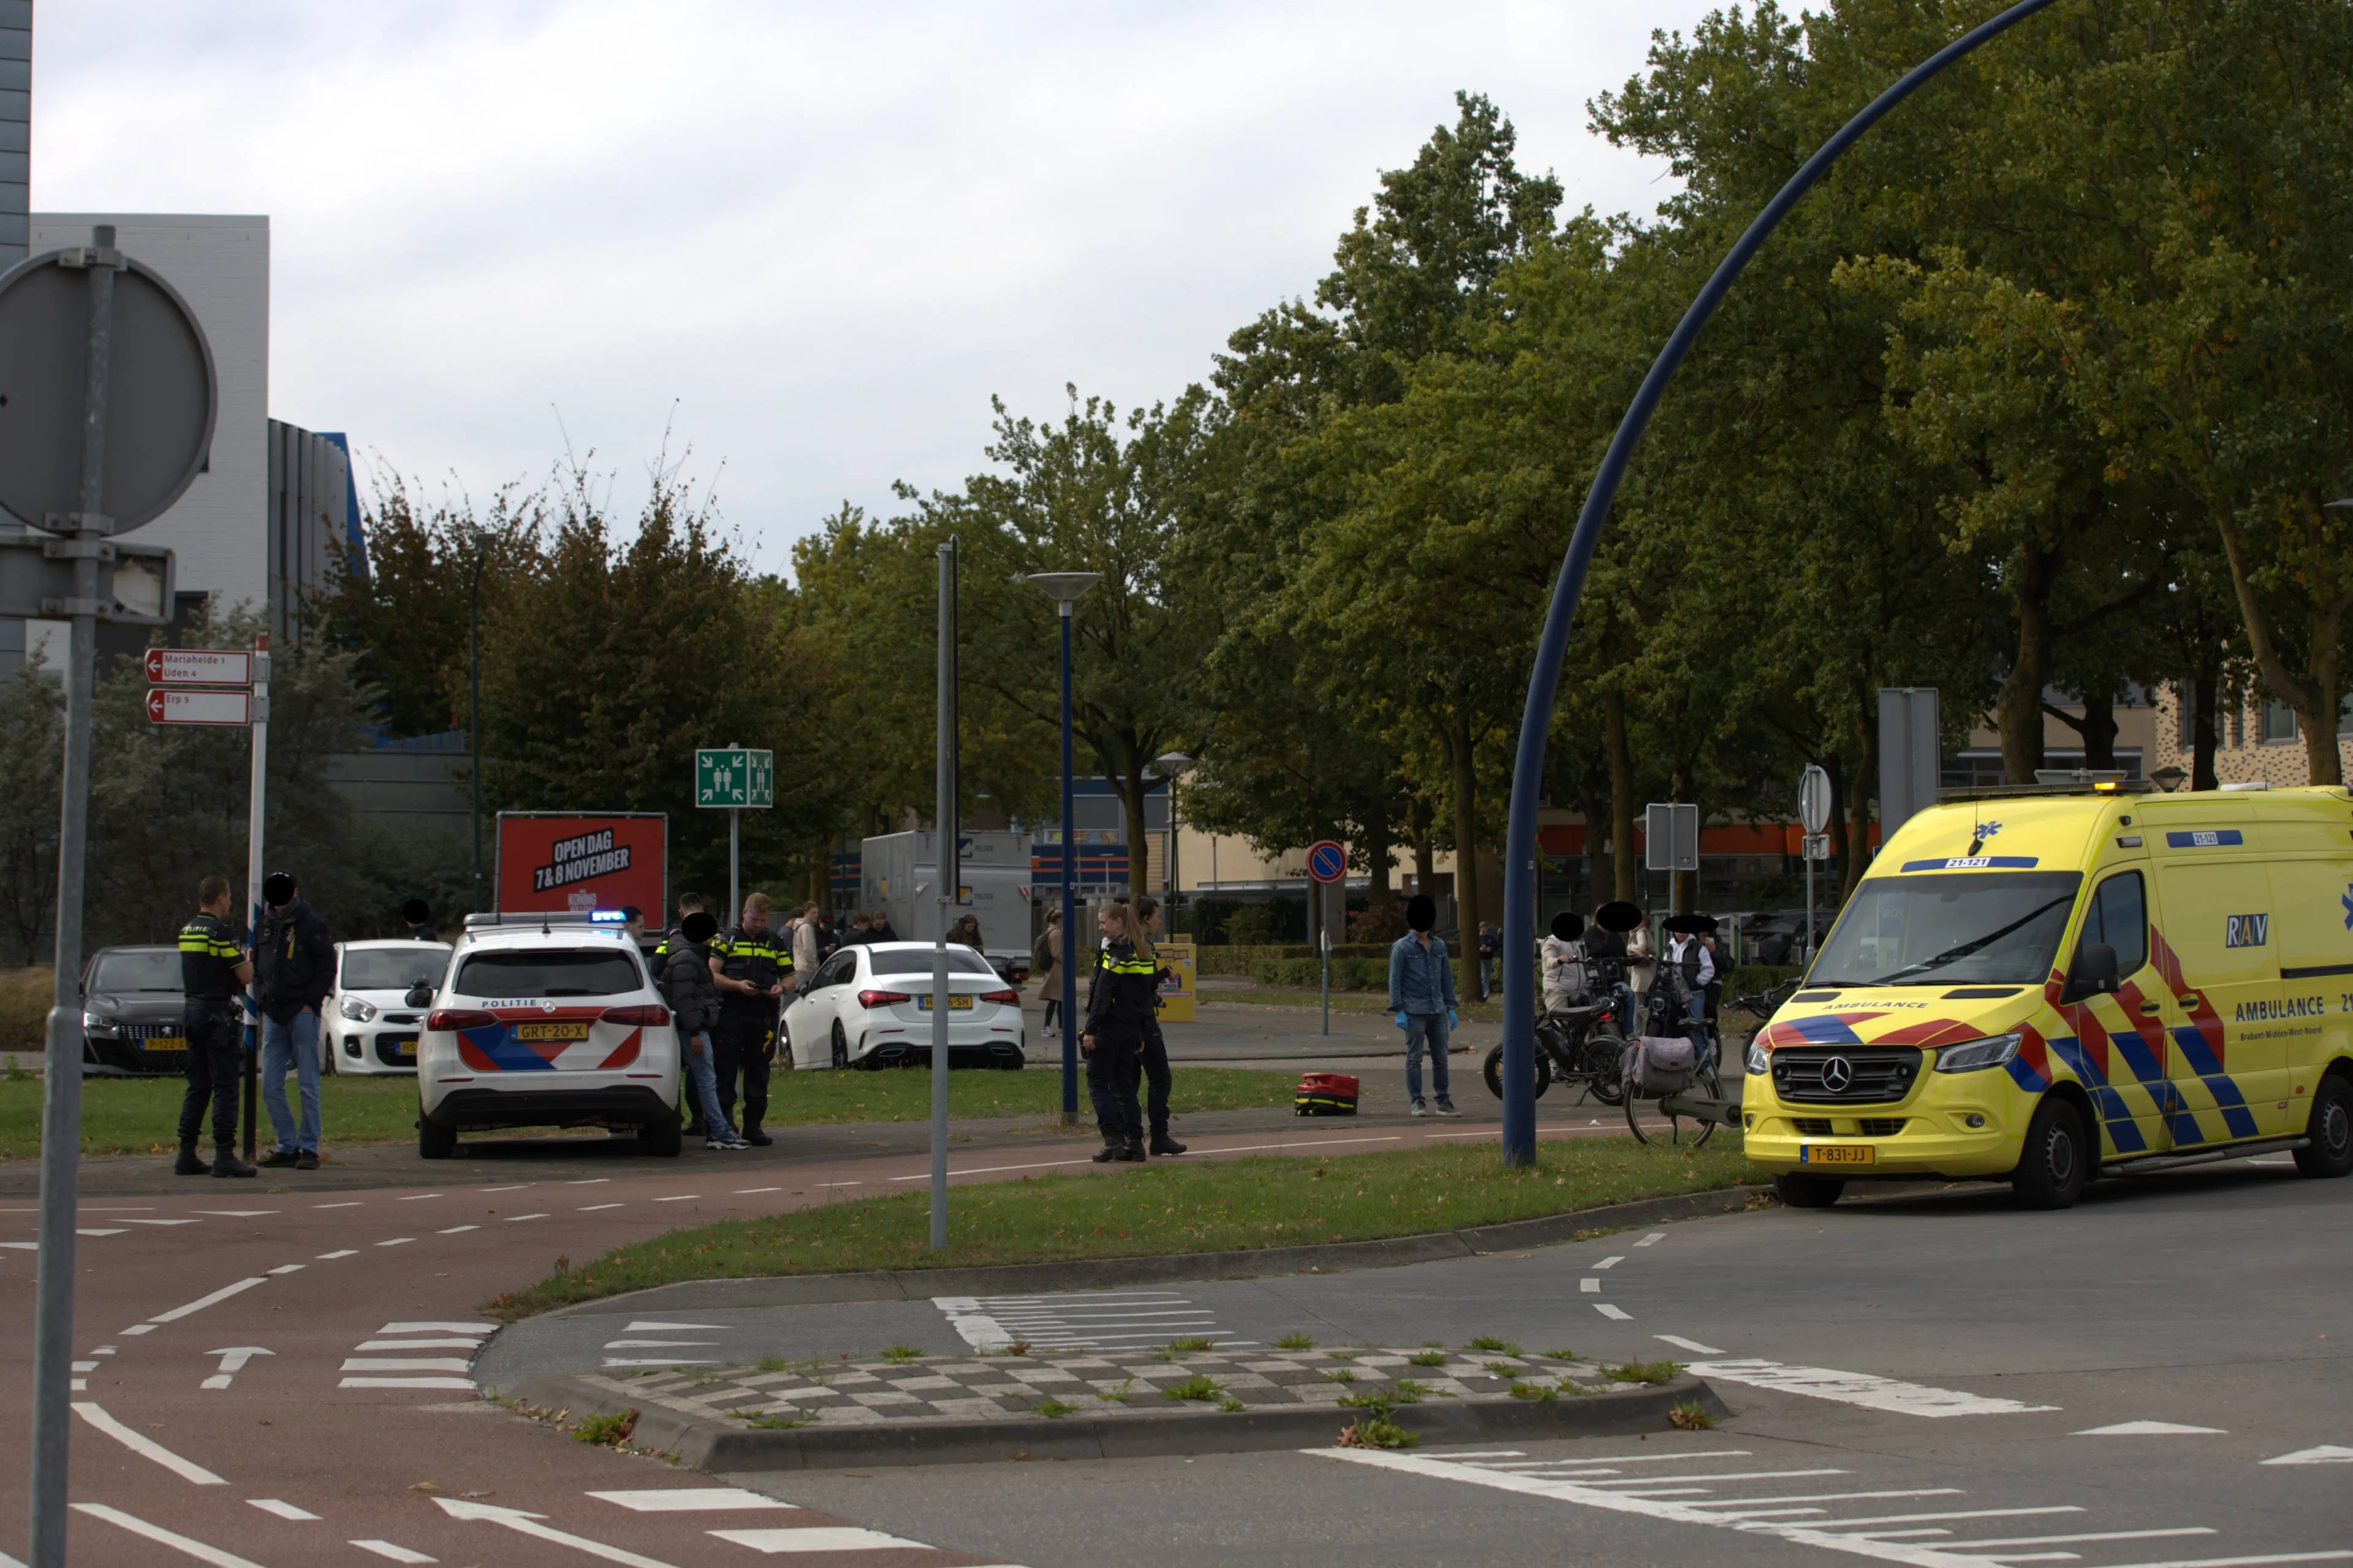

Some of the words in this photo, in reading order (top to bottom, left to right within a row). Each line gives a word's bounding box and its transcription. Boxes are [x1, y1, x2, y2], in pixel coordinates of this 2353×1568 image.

[165, 655, 218, 664] Mariaheide
[166, 694, 181, 703] Erp
[2195, 834, 2216, 843] 21-121
[555, 836, 586, 863] OPEN
[586, 830, 612, 854] DAG
[565, 848, 629, 882] NOVEMBER
[2227, 915, 2267, 945] RAV
[482, 999, 536, 1008] POLITIE
[2236, 996, 2324, 1022] AMBULANCE
[522, 1026, 583, 1037] GRT-20-X
[2240, 1026, 2322, 1041] Brabant-Midden-West-Noord
[150, 1040, 186, 1049] P-122-X
[1815, 1149, 1864, 1161] T-831-JJ
